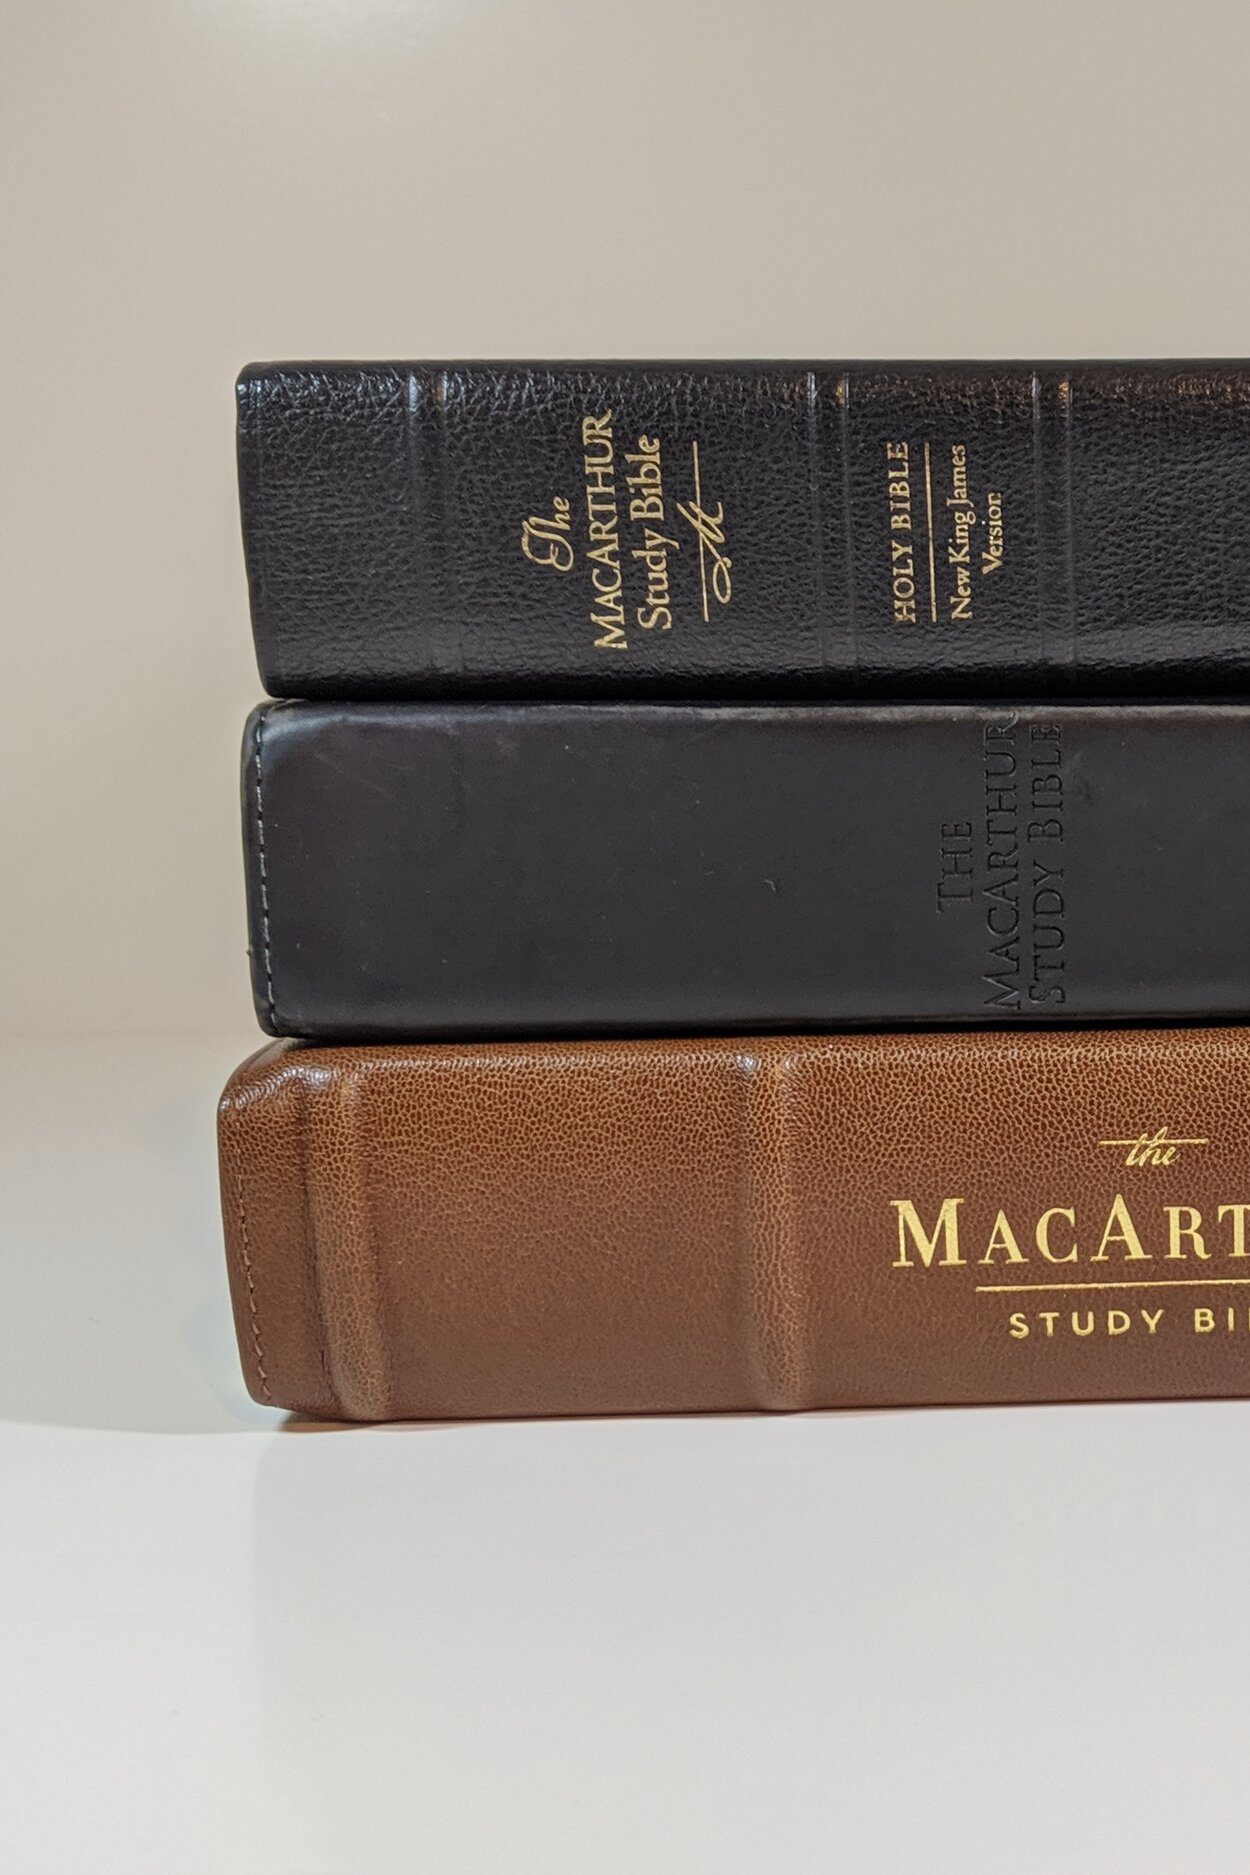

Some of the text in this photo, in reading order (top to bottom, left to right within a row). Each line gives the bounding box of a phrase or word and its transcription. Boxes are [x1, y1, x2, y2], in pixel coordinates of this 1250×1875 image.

[521, 496, 574, 572] The
[582, 408, 628, 649] MACARTHUR
[625, 434, 680, 629] Study Bible
[887, 441, 916, 623] HOLY BIBLE
[946, 444, 976, 620] New King James
[981, 492, 1004, 574] Version
[1099, 1126, 1209, 1167] the
[1009, 1309, 1164, 1339] STUDY
